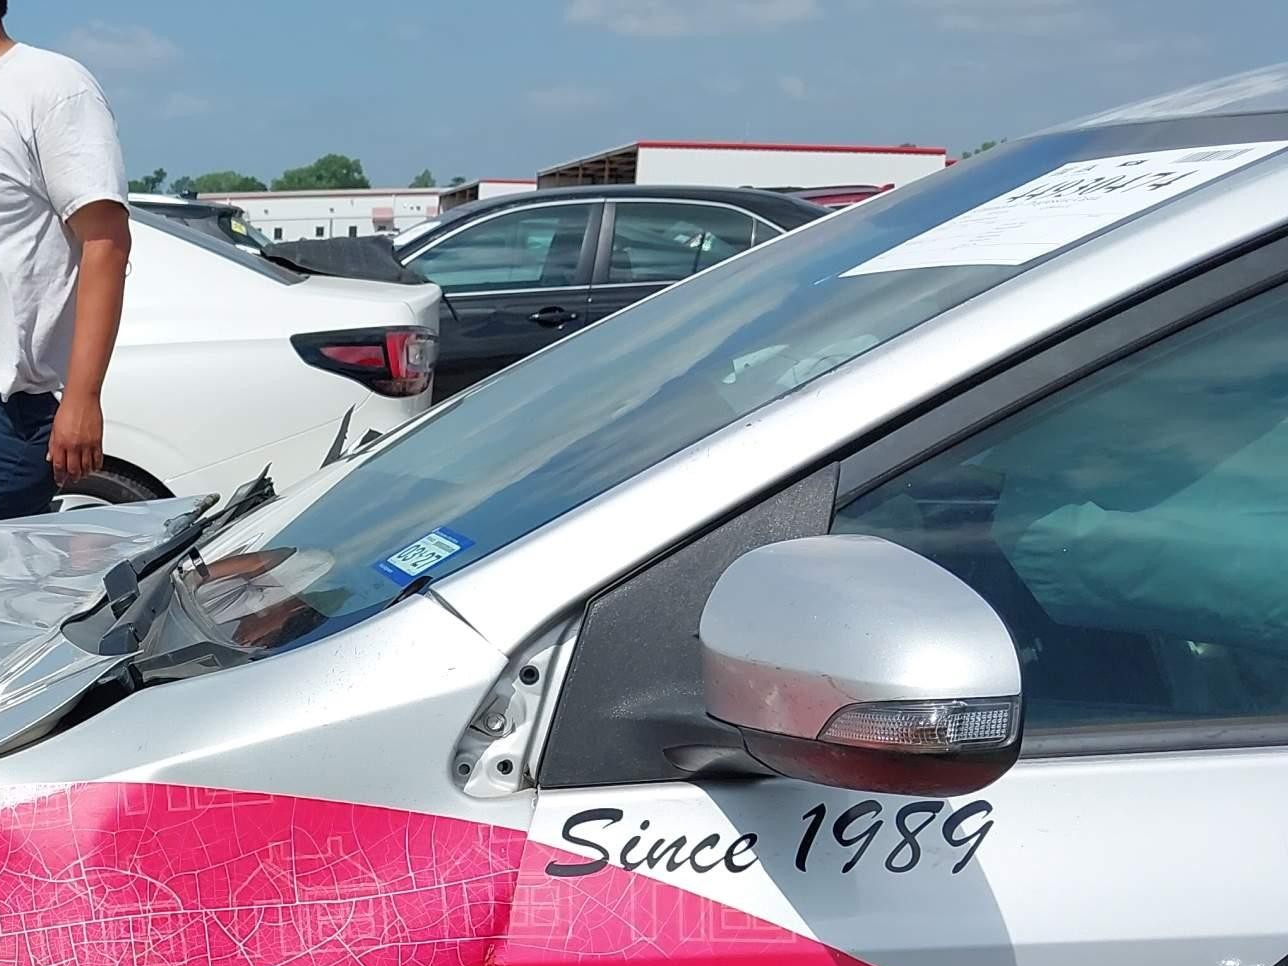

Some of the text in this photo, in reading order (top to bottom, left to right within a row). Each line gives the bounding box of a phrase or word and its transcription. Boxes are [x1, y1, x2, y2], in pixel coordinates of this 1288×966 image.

[1006, 169, 1200, 203] 44930474
[545, 799, 995, 877] Since 1989
